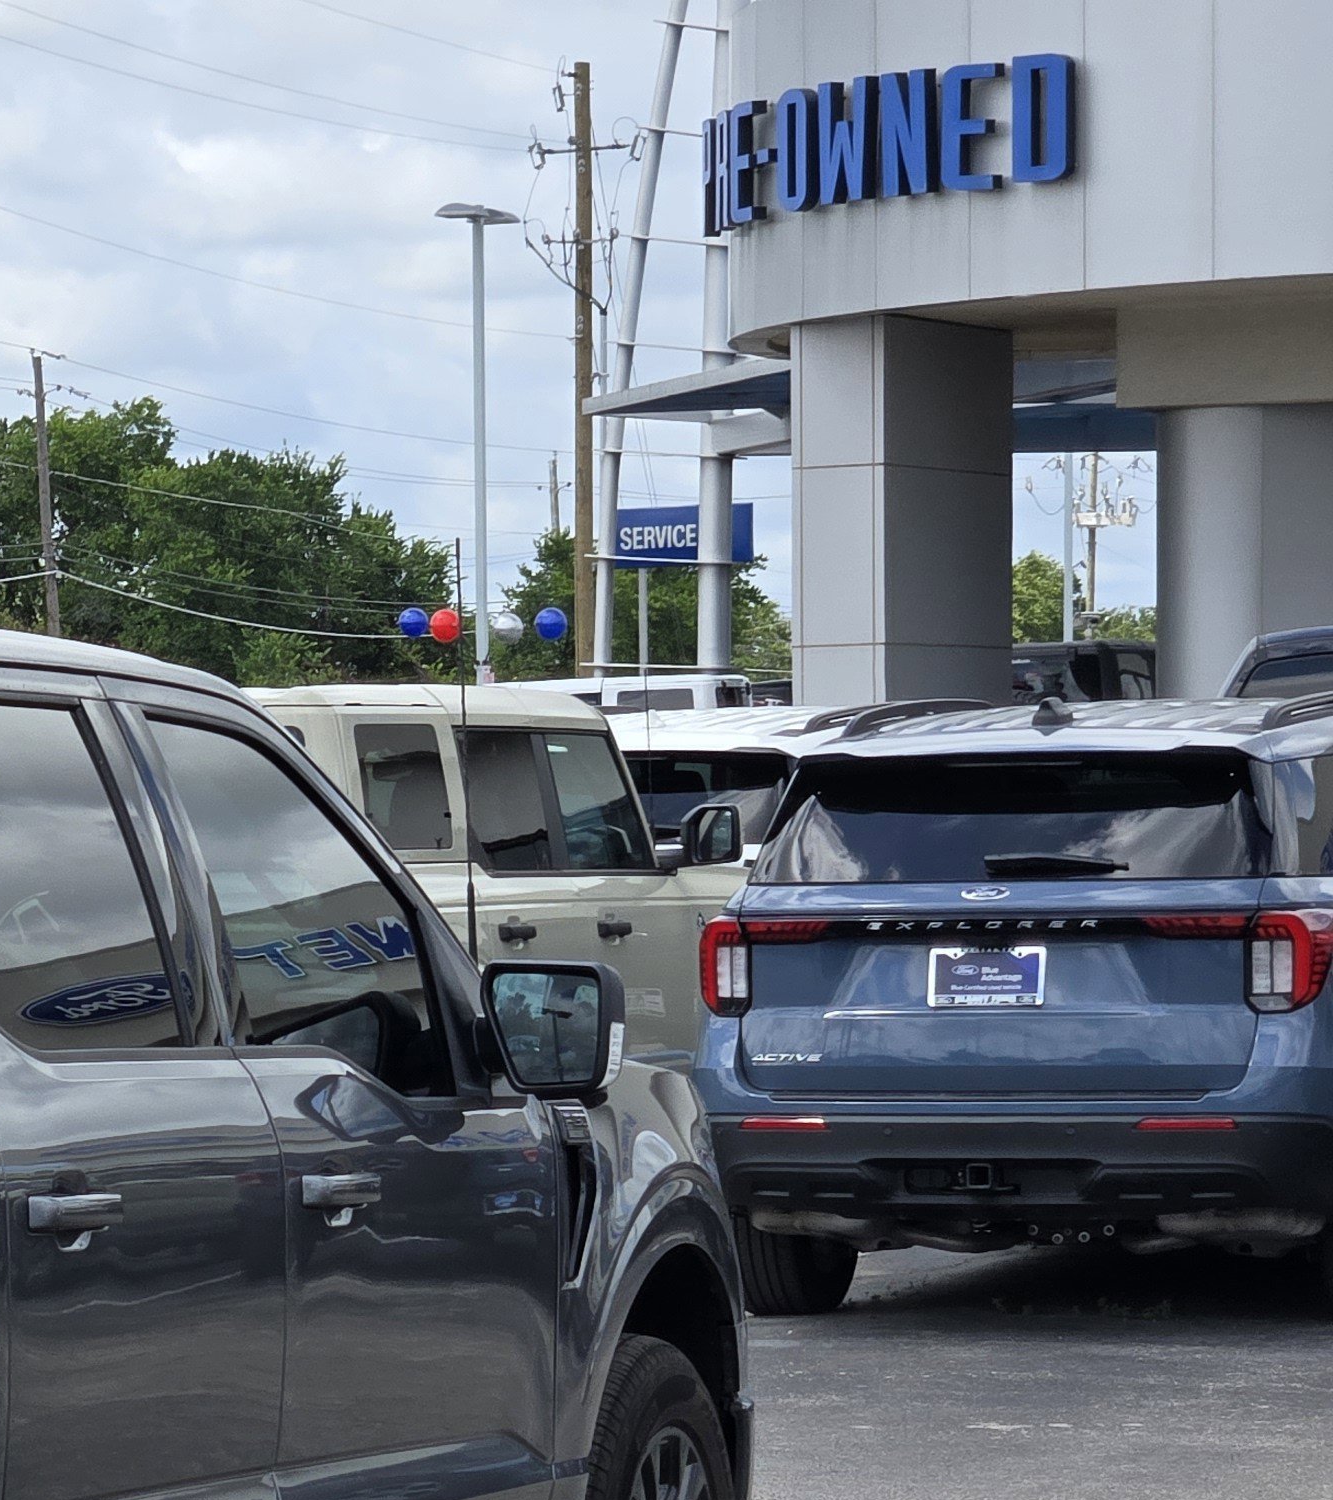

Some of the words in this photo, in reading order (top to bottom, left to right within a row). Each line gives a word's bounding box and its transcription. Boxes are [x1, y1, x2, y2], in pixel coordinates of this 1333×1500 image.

[703, 53, 1076, 238] PRE-OWNED
[619, 523, 697, 550] SERVICE
[866, 919, 1099, 931] EXPLORER
[751, 1053, 823, 1062] ACTIVE
